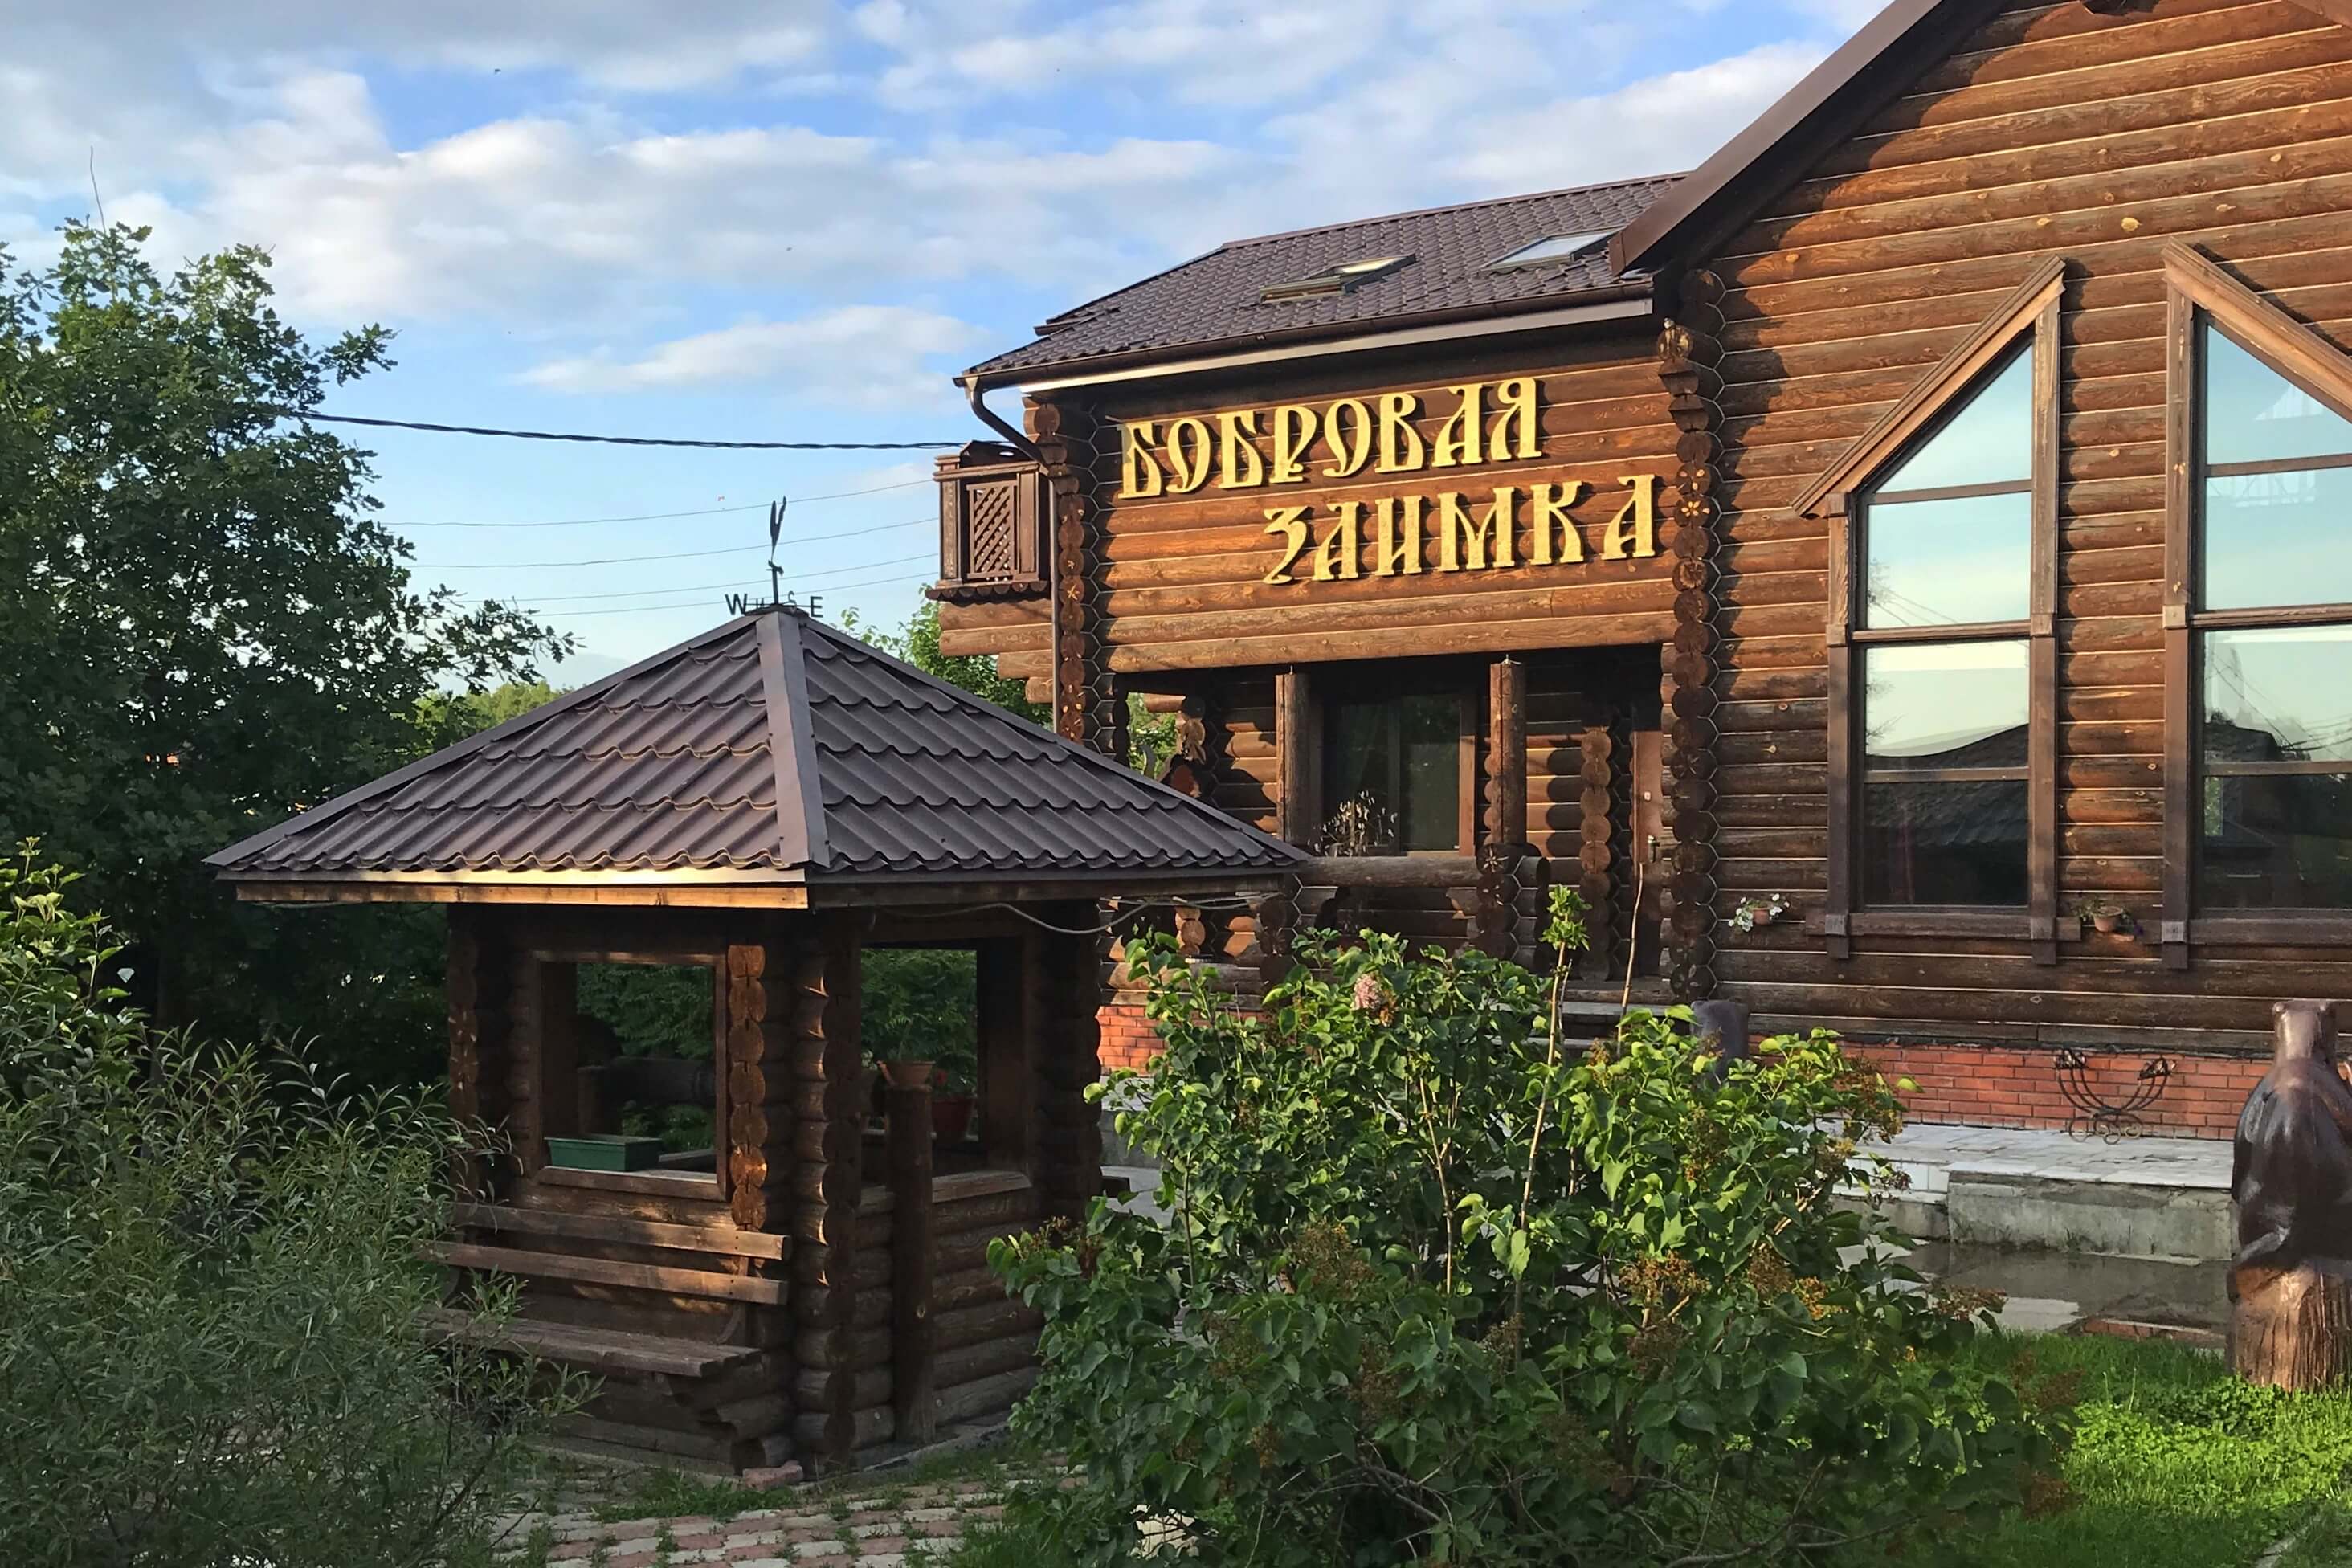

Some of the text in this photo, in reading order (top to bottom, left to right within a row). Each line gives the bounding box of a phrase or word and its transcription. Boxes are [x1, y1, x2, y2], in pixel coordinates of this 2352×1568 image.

[1118, 377, 1543, 499] БОБРОВАЯ
[1263, 474, 1656, 585] ЗАИМКА
[725, 593, 748, 615] W
[810, 595, 823, 618] E
